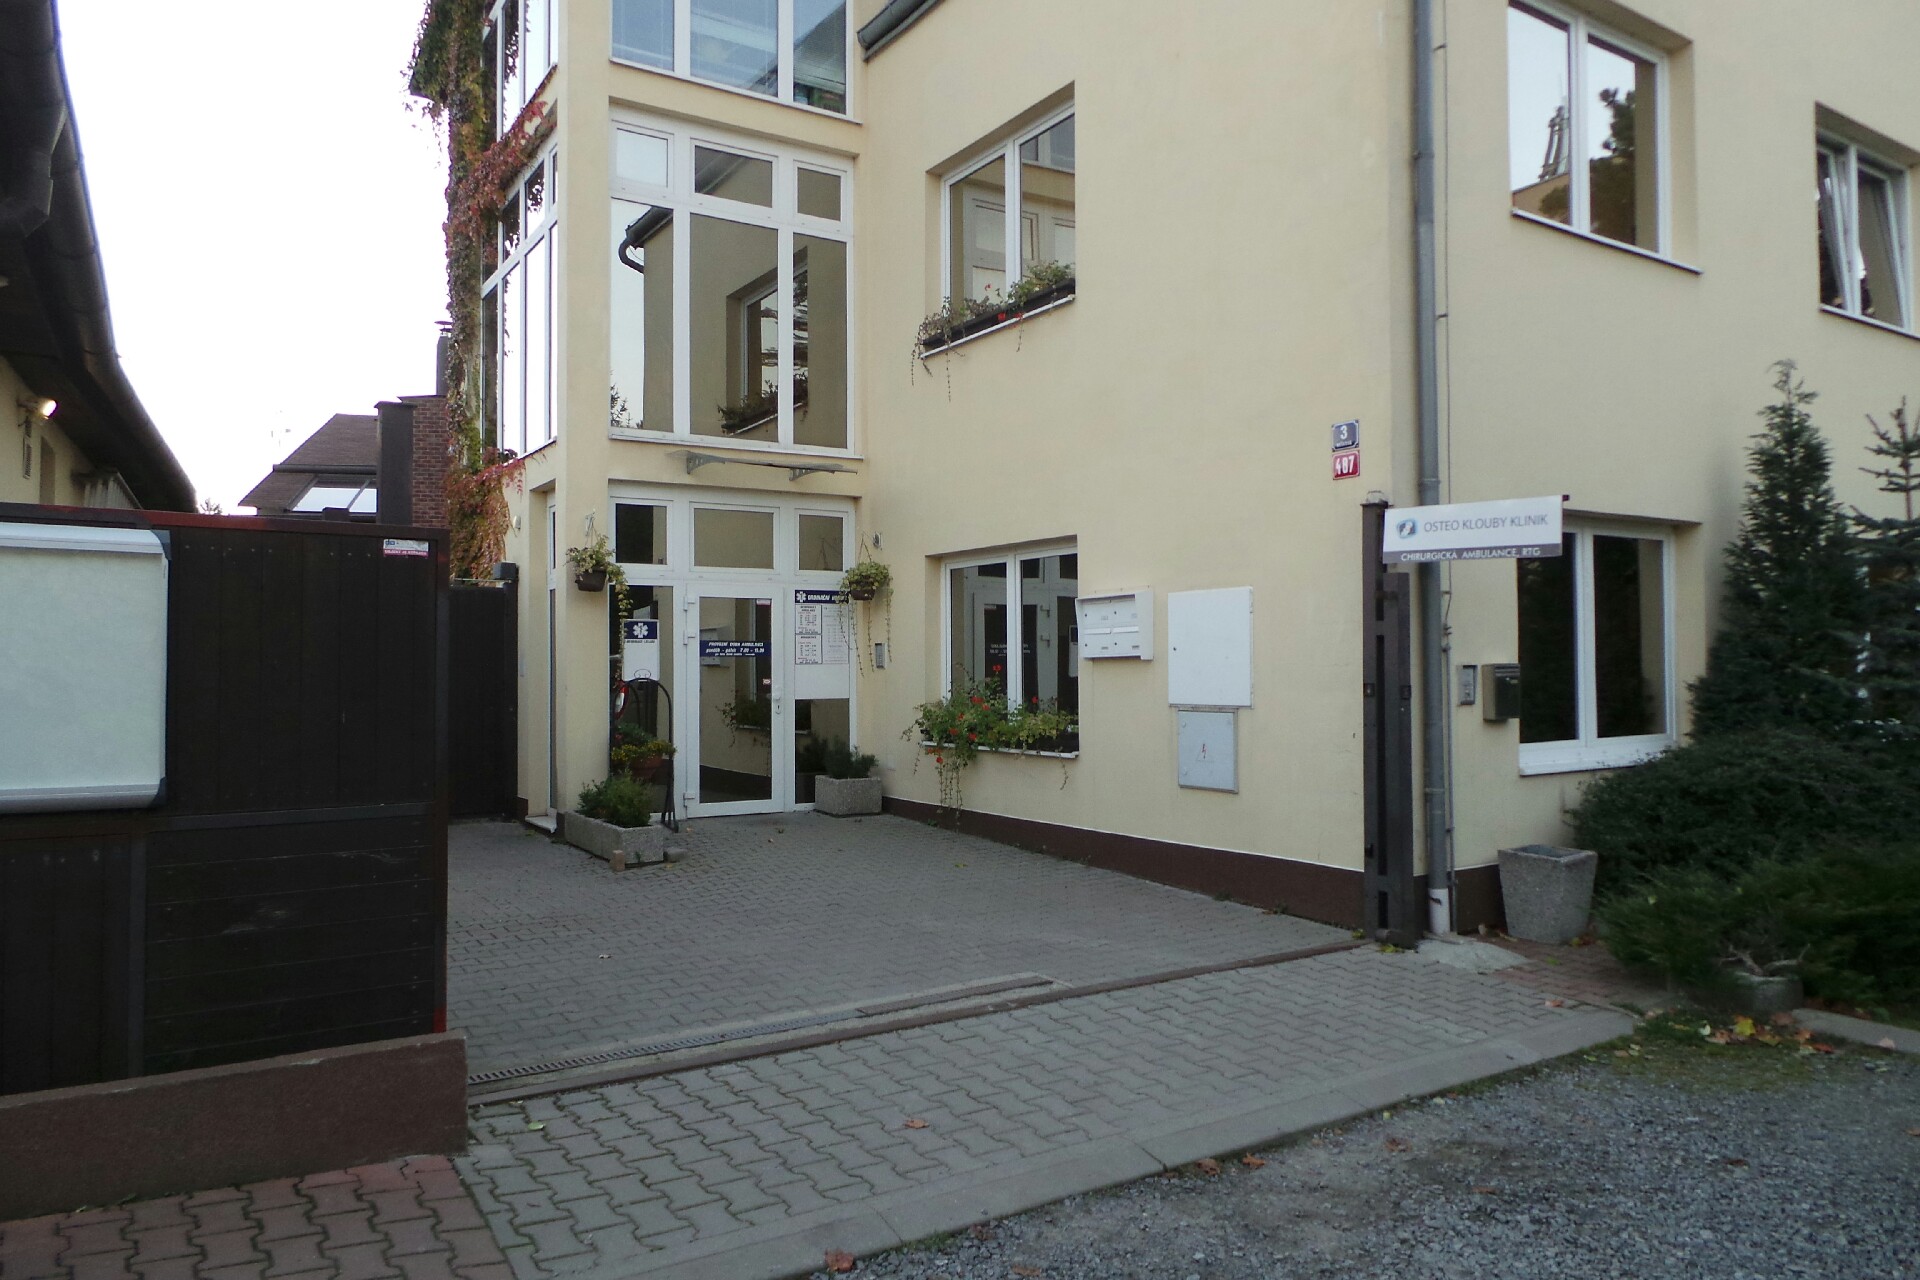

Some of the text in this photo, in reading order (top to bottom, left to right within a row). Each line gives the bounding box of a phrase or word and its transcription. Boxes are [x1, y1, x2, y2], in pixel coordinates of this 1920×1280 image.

[1340, 425, 1348, 440] 3
[1336, 455, 1355, 475] 487
[1423, 514, 1549, 533] OSTEO KLOUBY KLINIK
[1522, 547, 1541, 556] RTG
